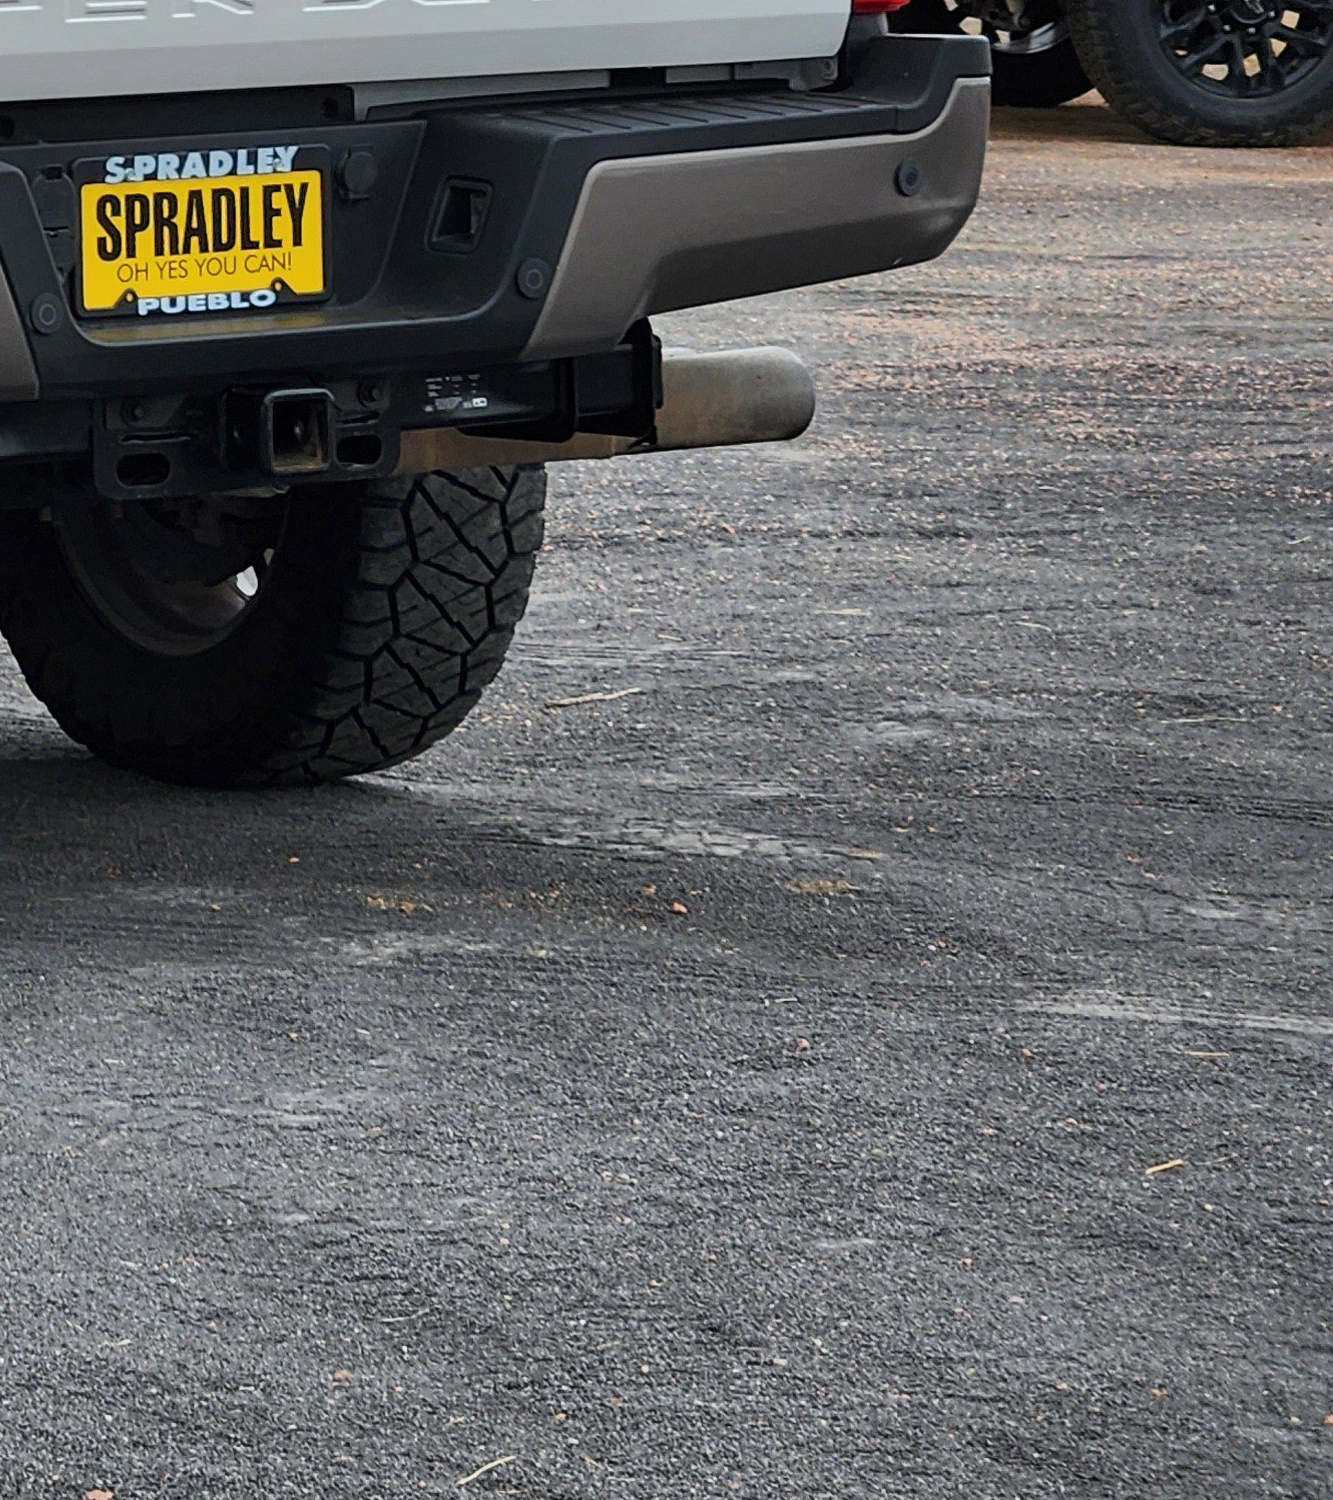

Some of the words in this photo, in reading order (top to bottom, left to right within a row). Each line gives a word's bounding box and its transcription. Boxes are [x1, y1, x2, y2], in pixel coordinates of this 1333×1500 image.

[104, 145, 300, 184] SPRADLEY
[96, 182, 309, 262] SPRADLEY
[117, 263, 149, 283] OH
[155, 259, 188, 281] YES
[194, 255, 237, 277] YOU
[244, 251, 293, 274] CAN!
[137, 288, 277, 316] PUEBLO
